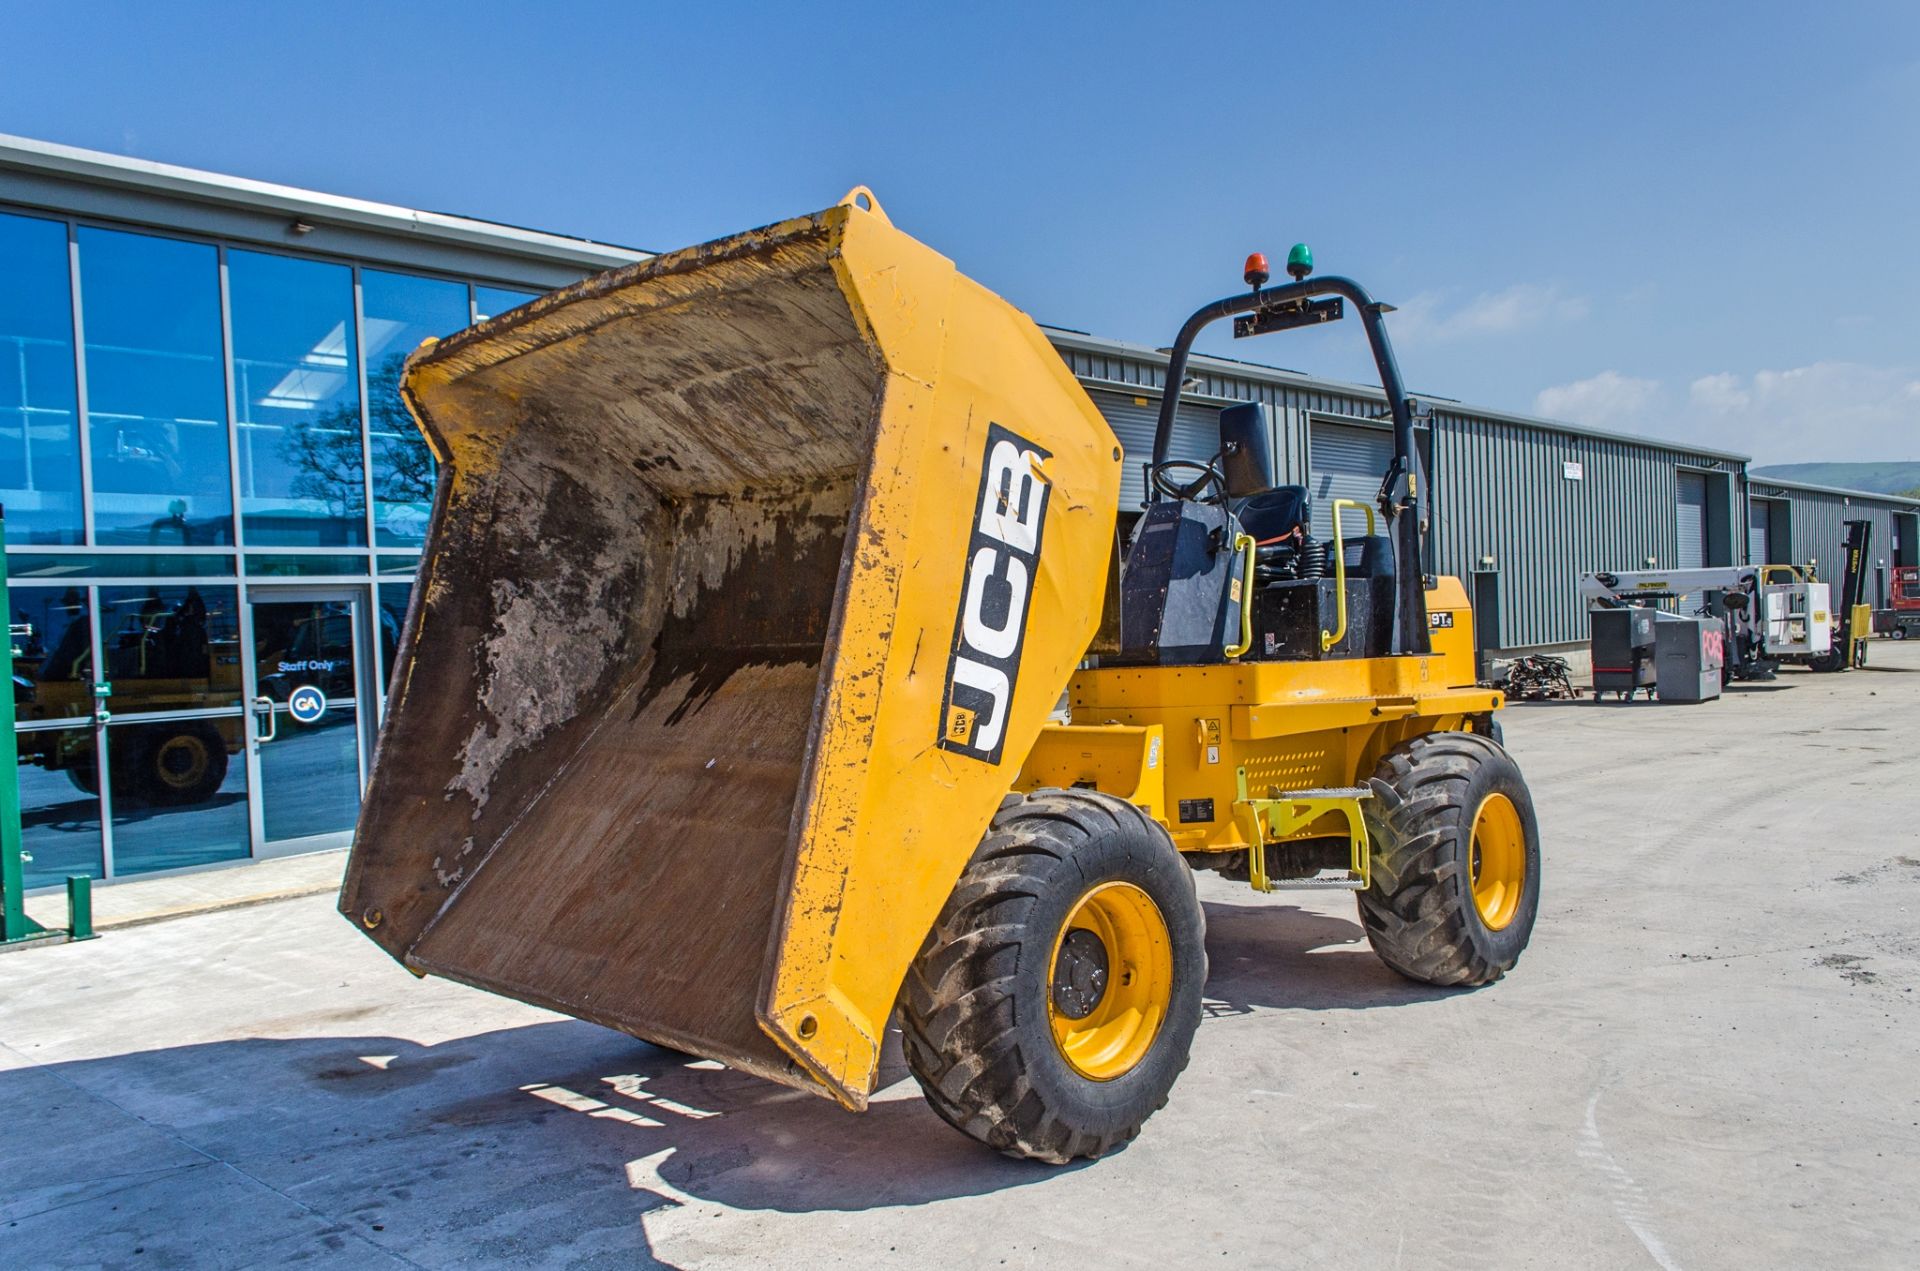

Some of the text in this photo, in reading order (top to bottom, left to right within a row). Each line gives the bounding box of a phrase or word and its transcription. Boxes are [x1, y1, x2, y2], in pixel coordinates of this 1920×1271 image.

[953, 440, 1047, 752] JCB
[278, 660, 334, 672] Staff Only
[295, 696, 319, 711] GA
[953, 714, 965, 734] JCB
